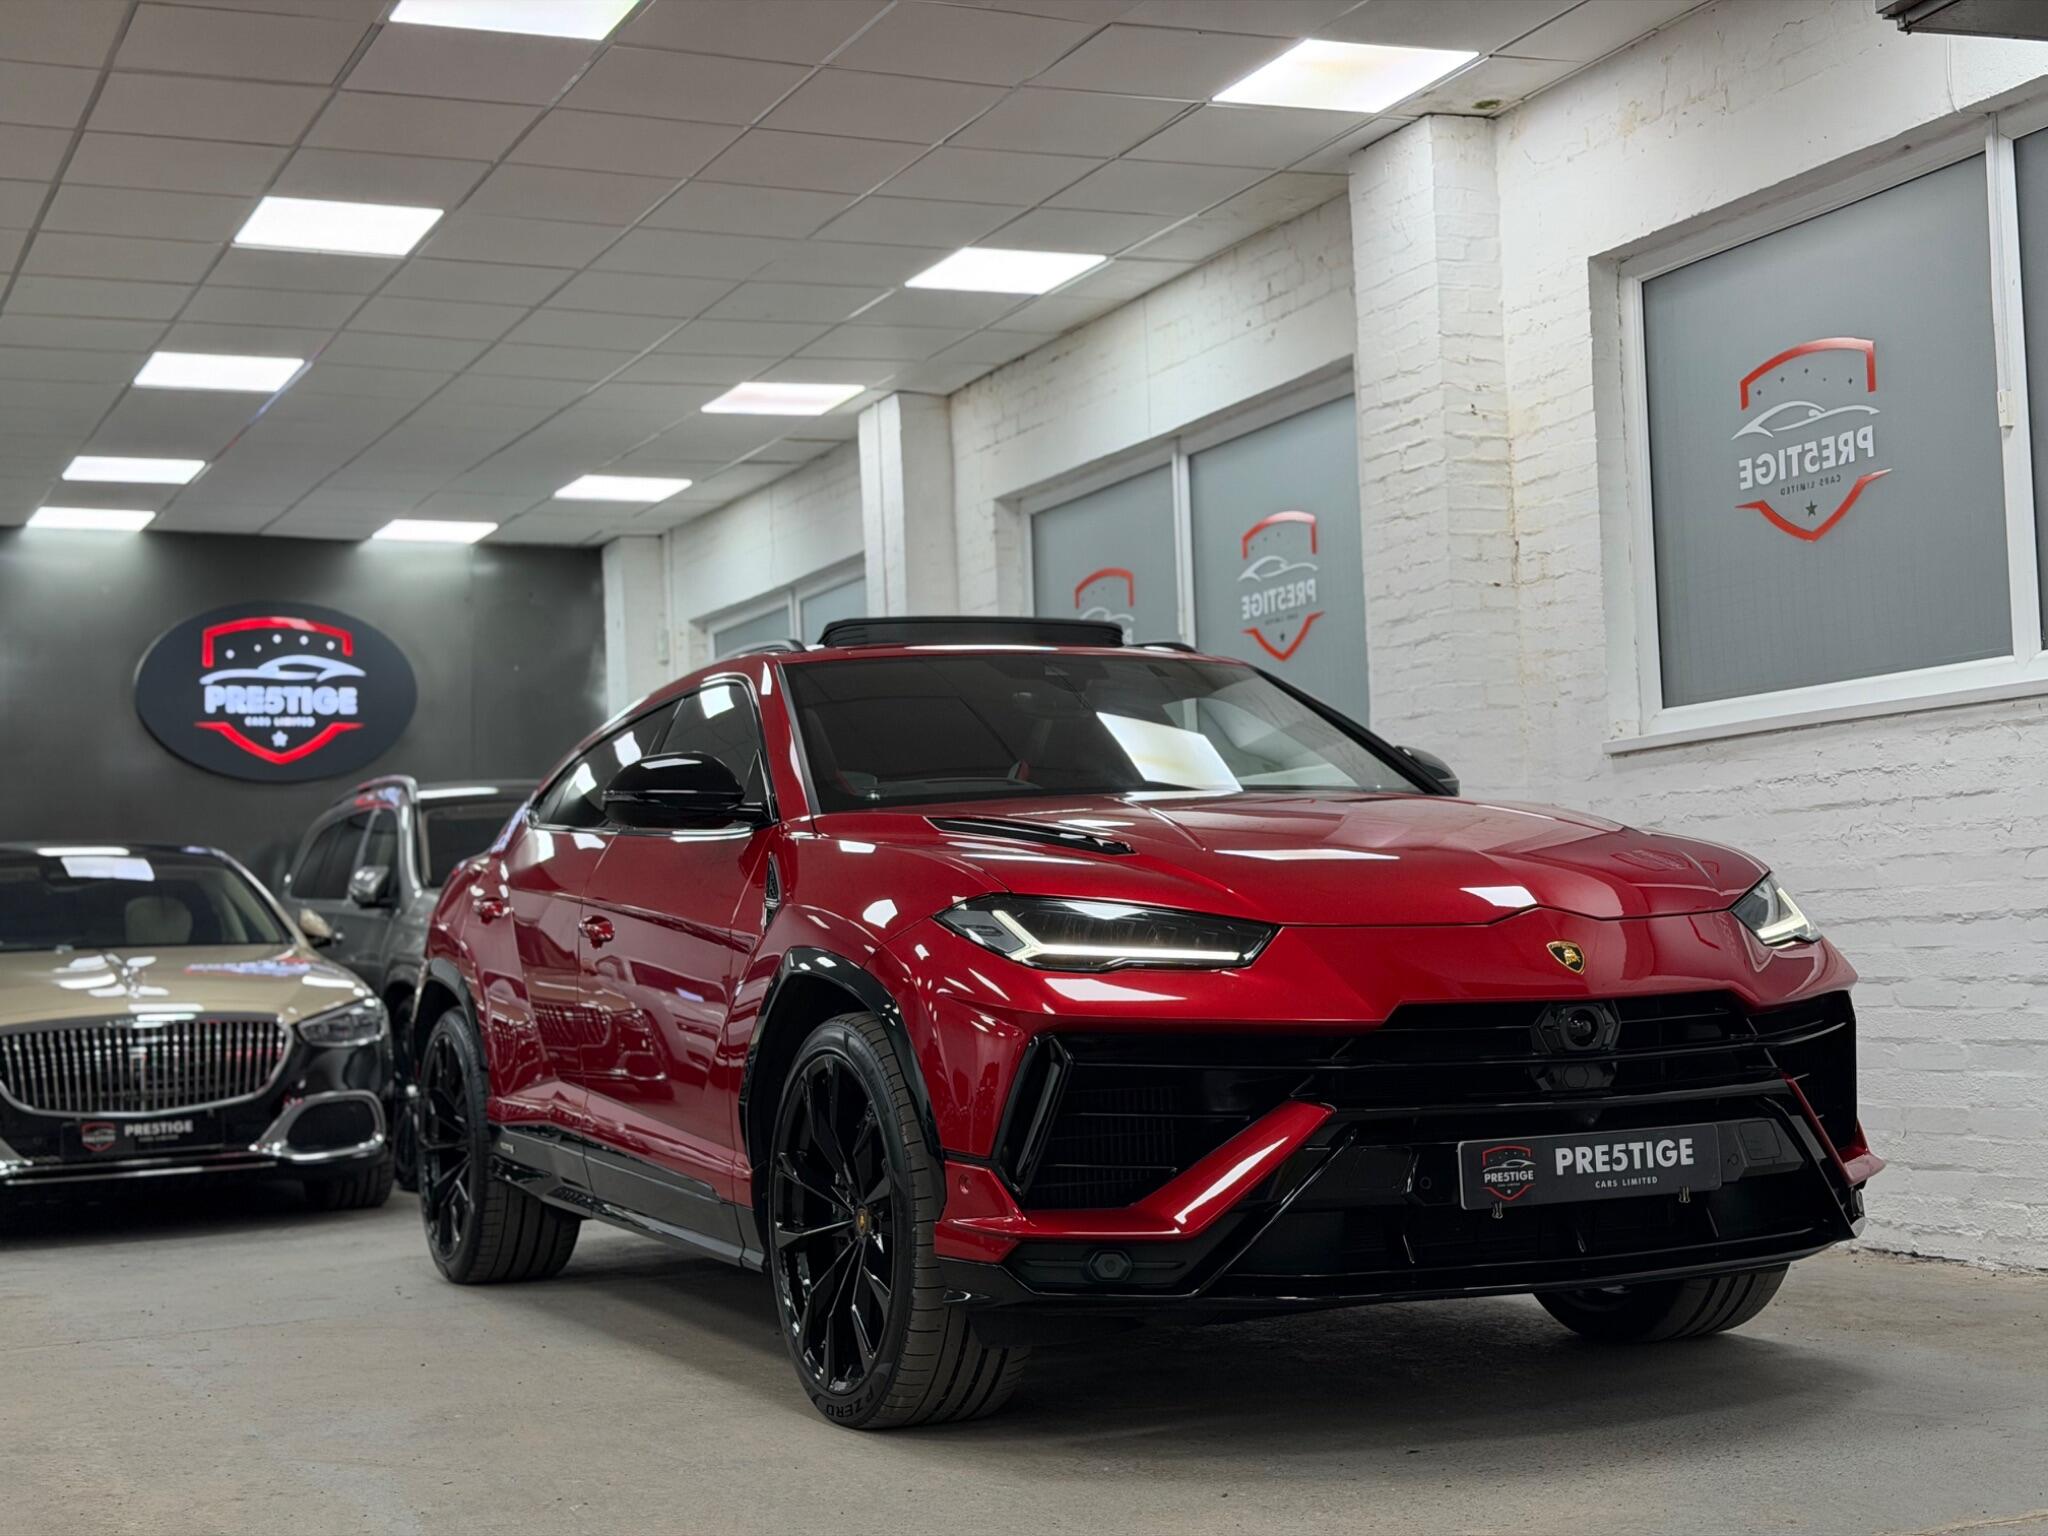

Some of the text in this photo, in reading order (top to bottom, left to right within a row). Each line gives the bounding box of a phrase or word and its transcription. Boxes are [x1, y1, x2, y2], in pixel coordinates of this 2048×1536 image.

[1595, 1176, 1658, 1189] CARS LIMITED
[826, 1398, 863, 1418] ZERO
